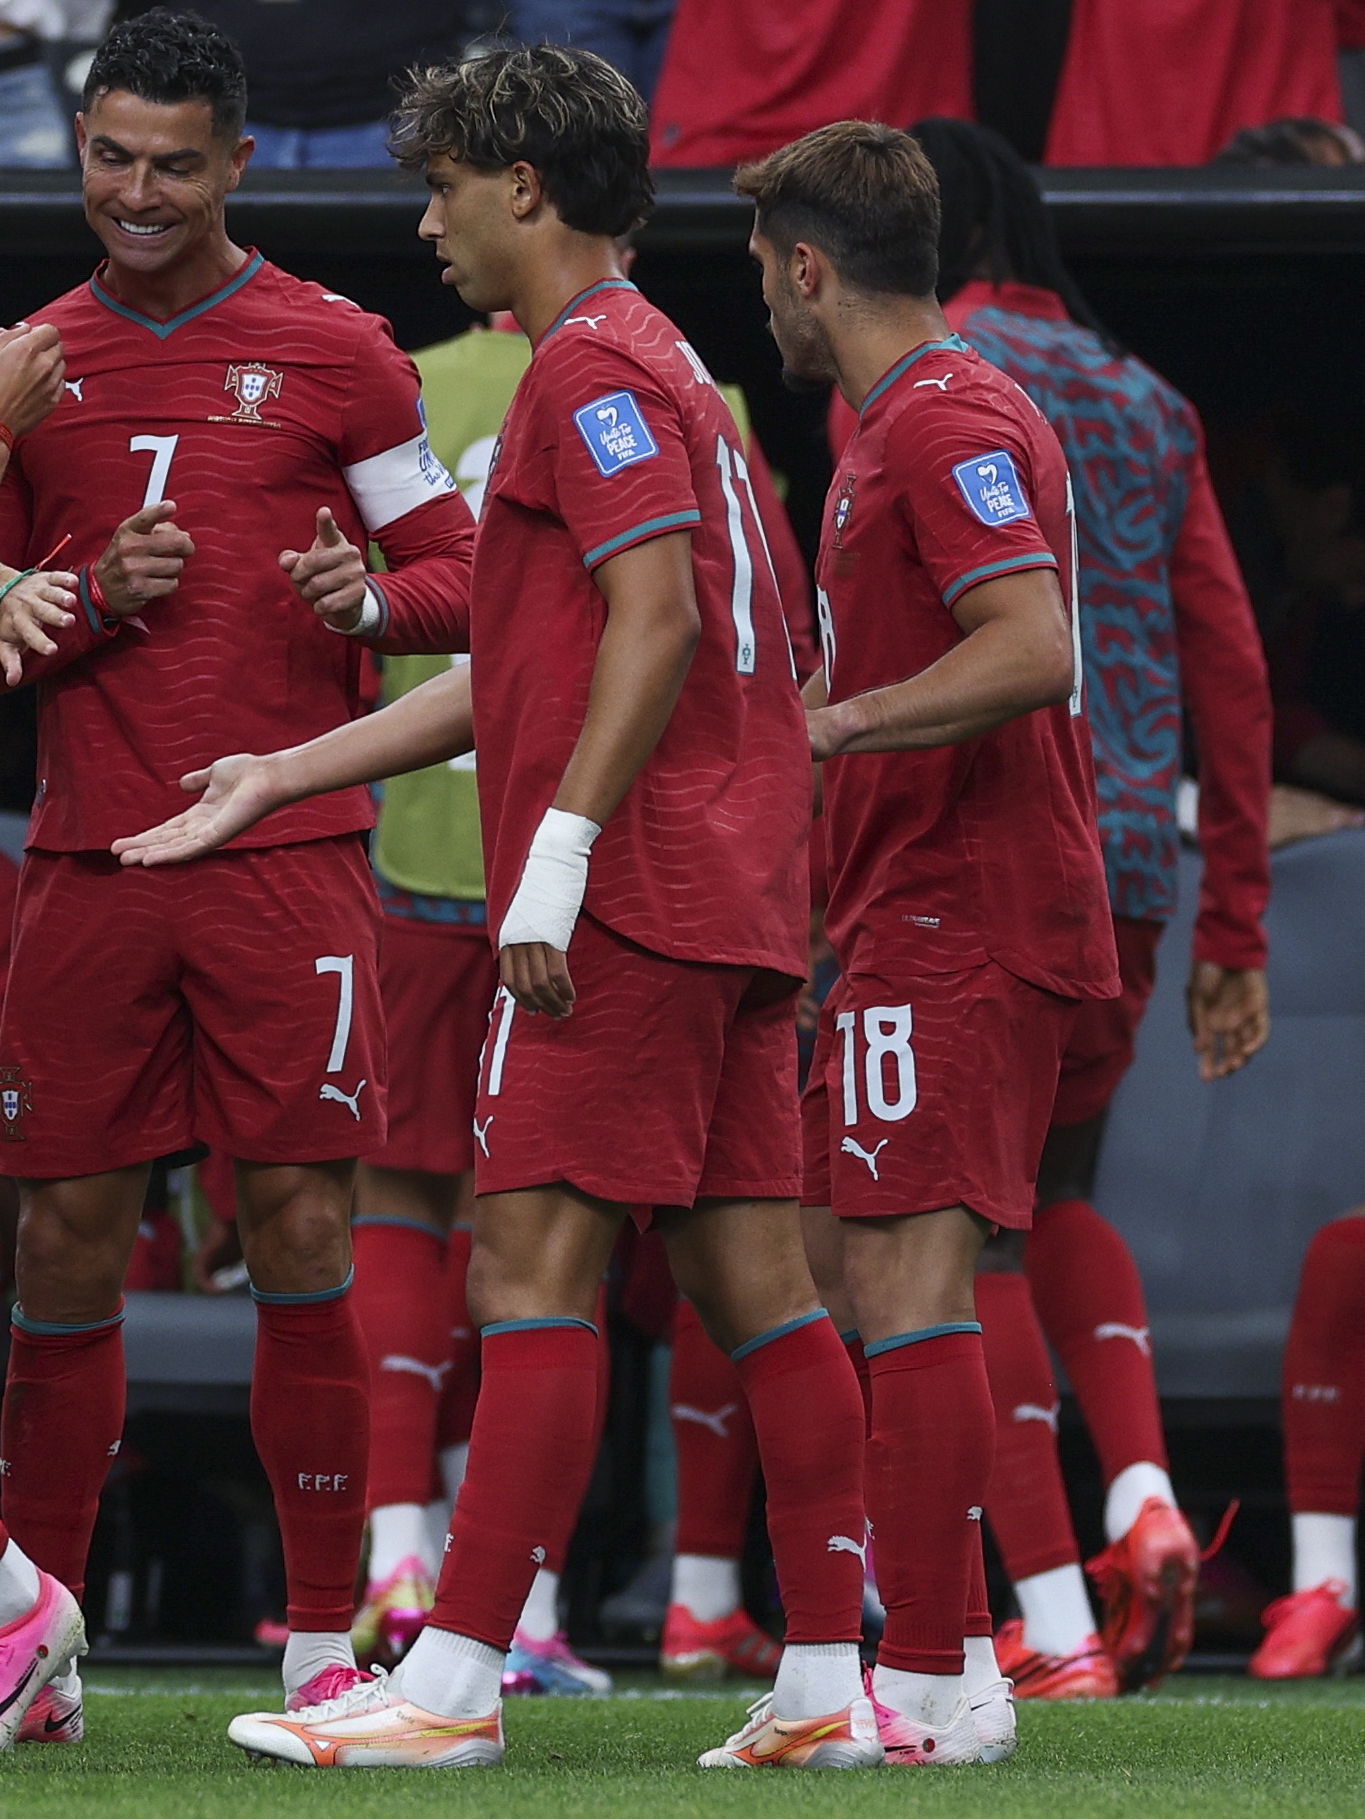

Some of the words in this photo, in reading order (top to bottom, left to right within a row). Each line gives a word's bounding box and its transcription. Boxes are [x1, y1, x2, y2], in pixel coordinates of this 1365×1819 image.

[606, 434, 638, 457] PEACE
[617, 449, 635, 461] FIFA
[130, 434, 179, 511] 7
[987, 494, 1014, 513] PEACE
[315, 954, 353, 1073] 7
[836, 1003, 917, 1126] 18
